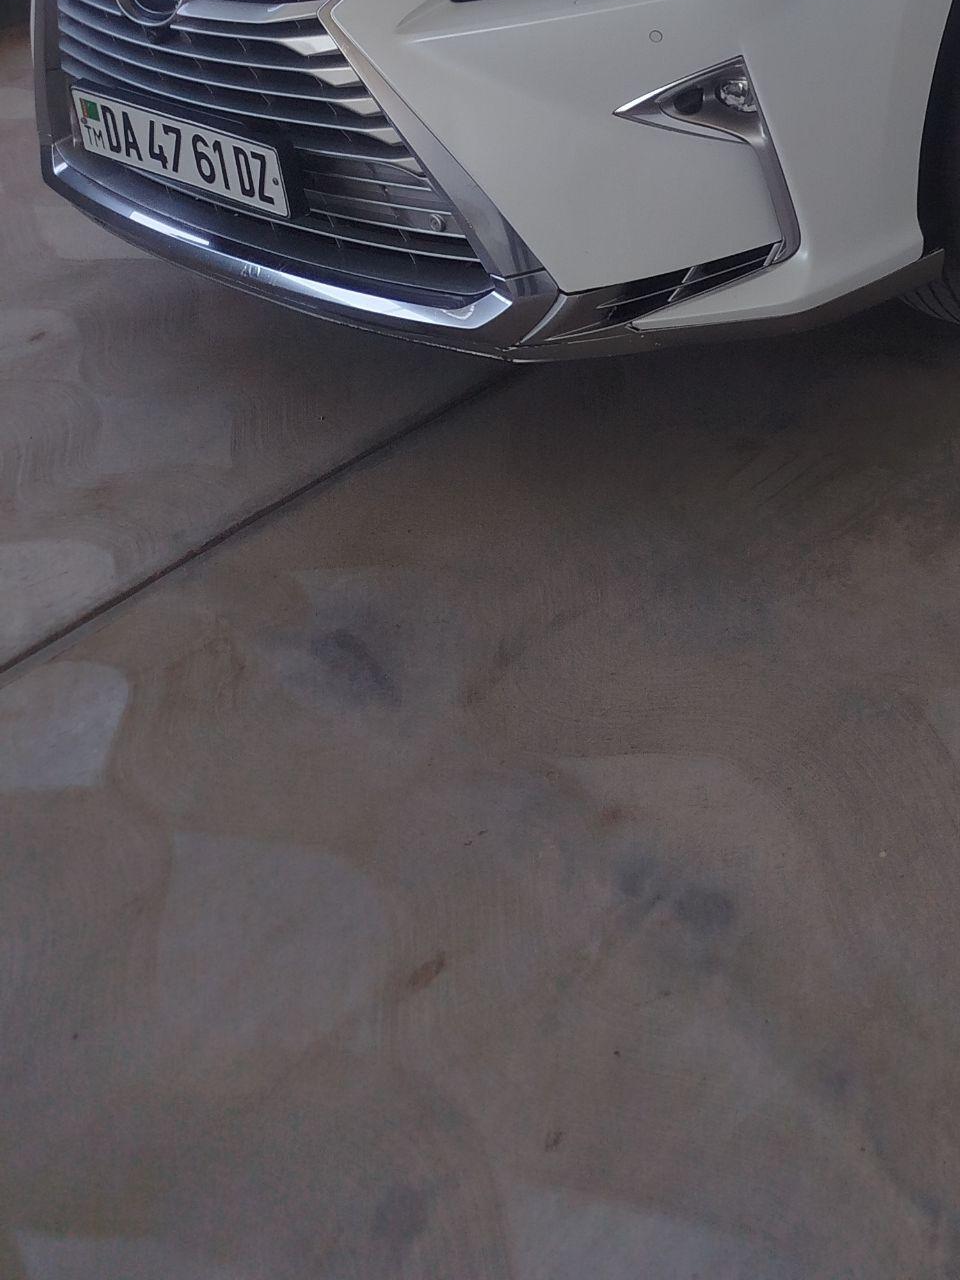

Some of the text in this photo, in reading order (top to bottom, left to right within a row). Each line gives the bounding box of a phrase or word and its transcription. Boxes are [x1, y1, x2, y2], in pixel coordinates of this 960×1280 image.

[84, 125, 106, 150] TM
[101, 105, 275, 205] DA 47 61 DZ
